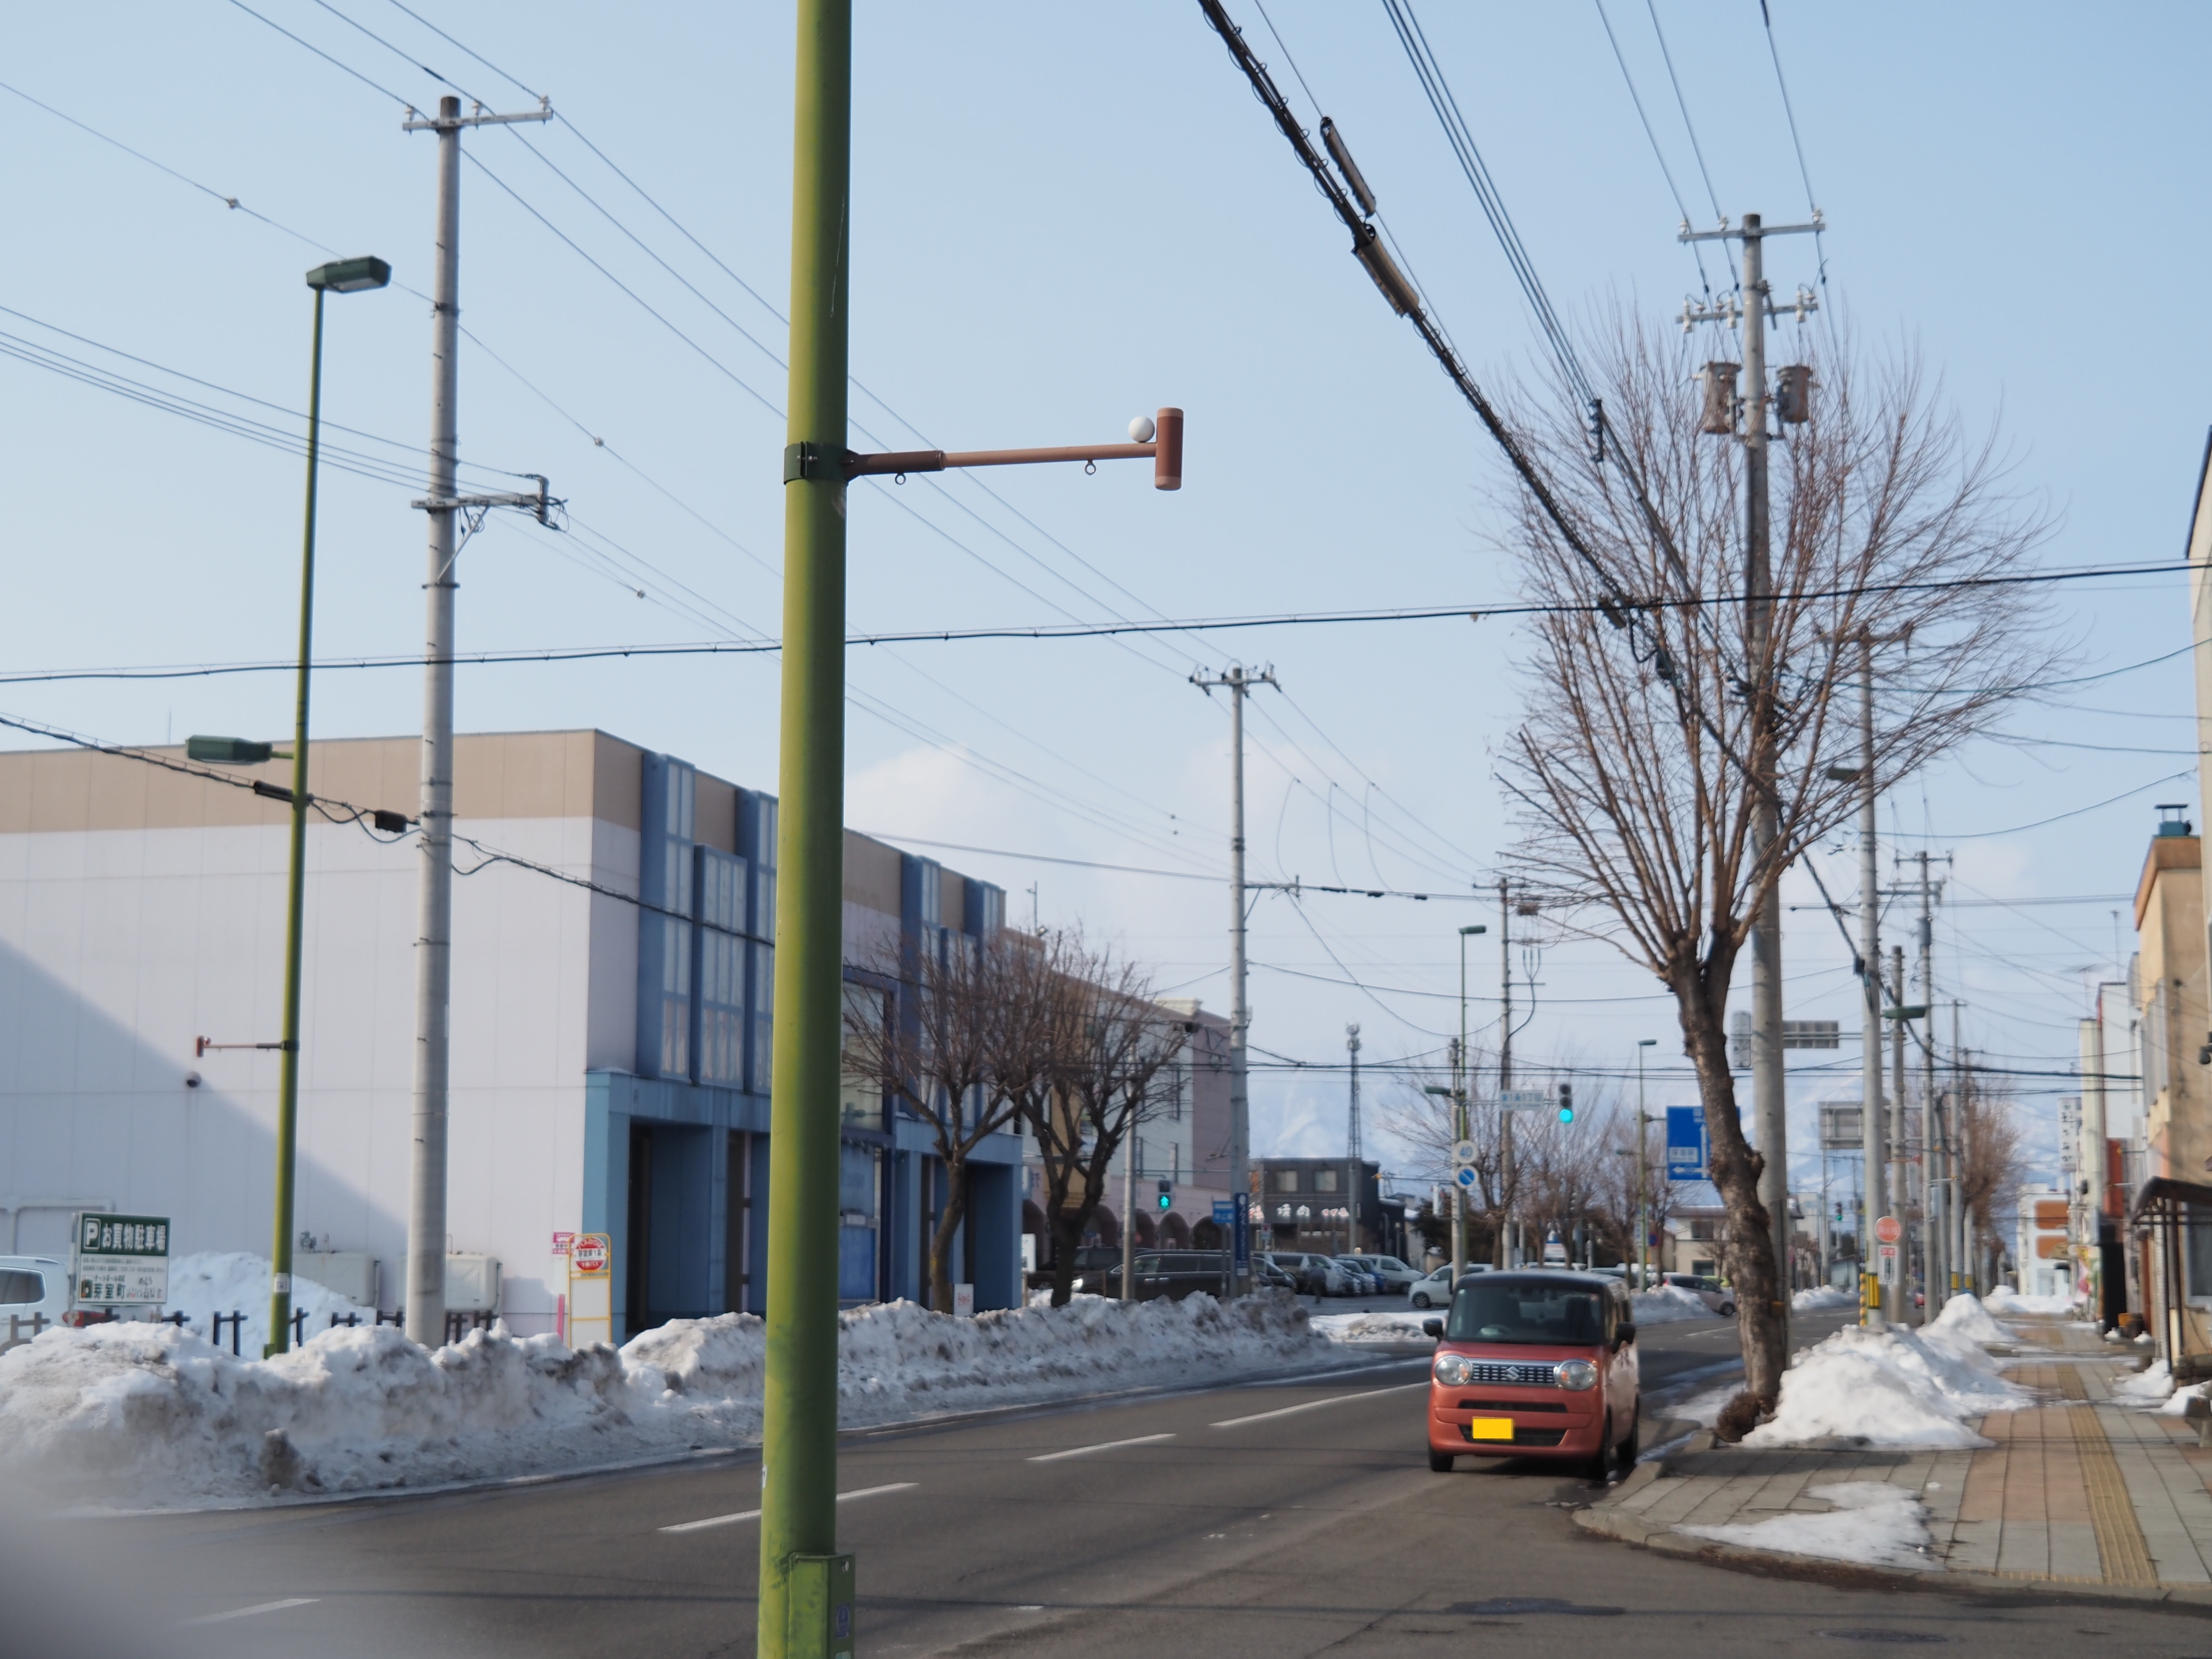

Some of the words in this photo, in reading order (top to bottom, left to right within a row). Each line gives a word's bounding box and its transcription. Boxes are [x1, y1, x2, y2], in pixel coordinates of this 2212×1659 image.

[1460, 1146, 1473, 1157] 40
[86, 1222, 99, 1246] P
[102, 1222, 166, 1251] お買物駐車場
[94, 1282, 126, 1299] 芽室町
